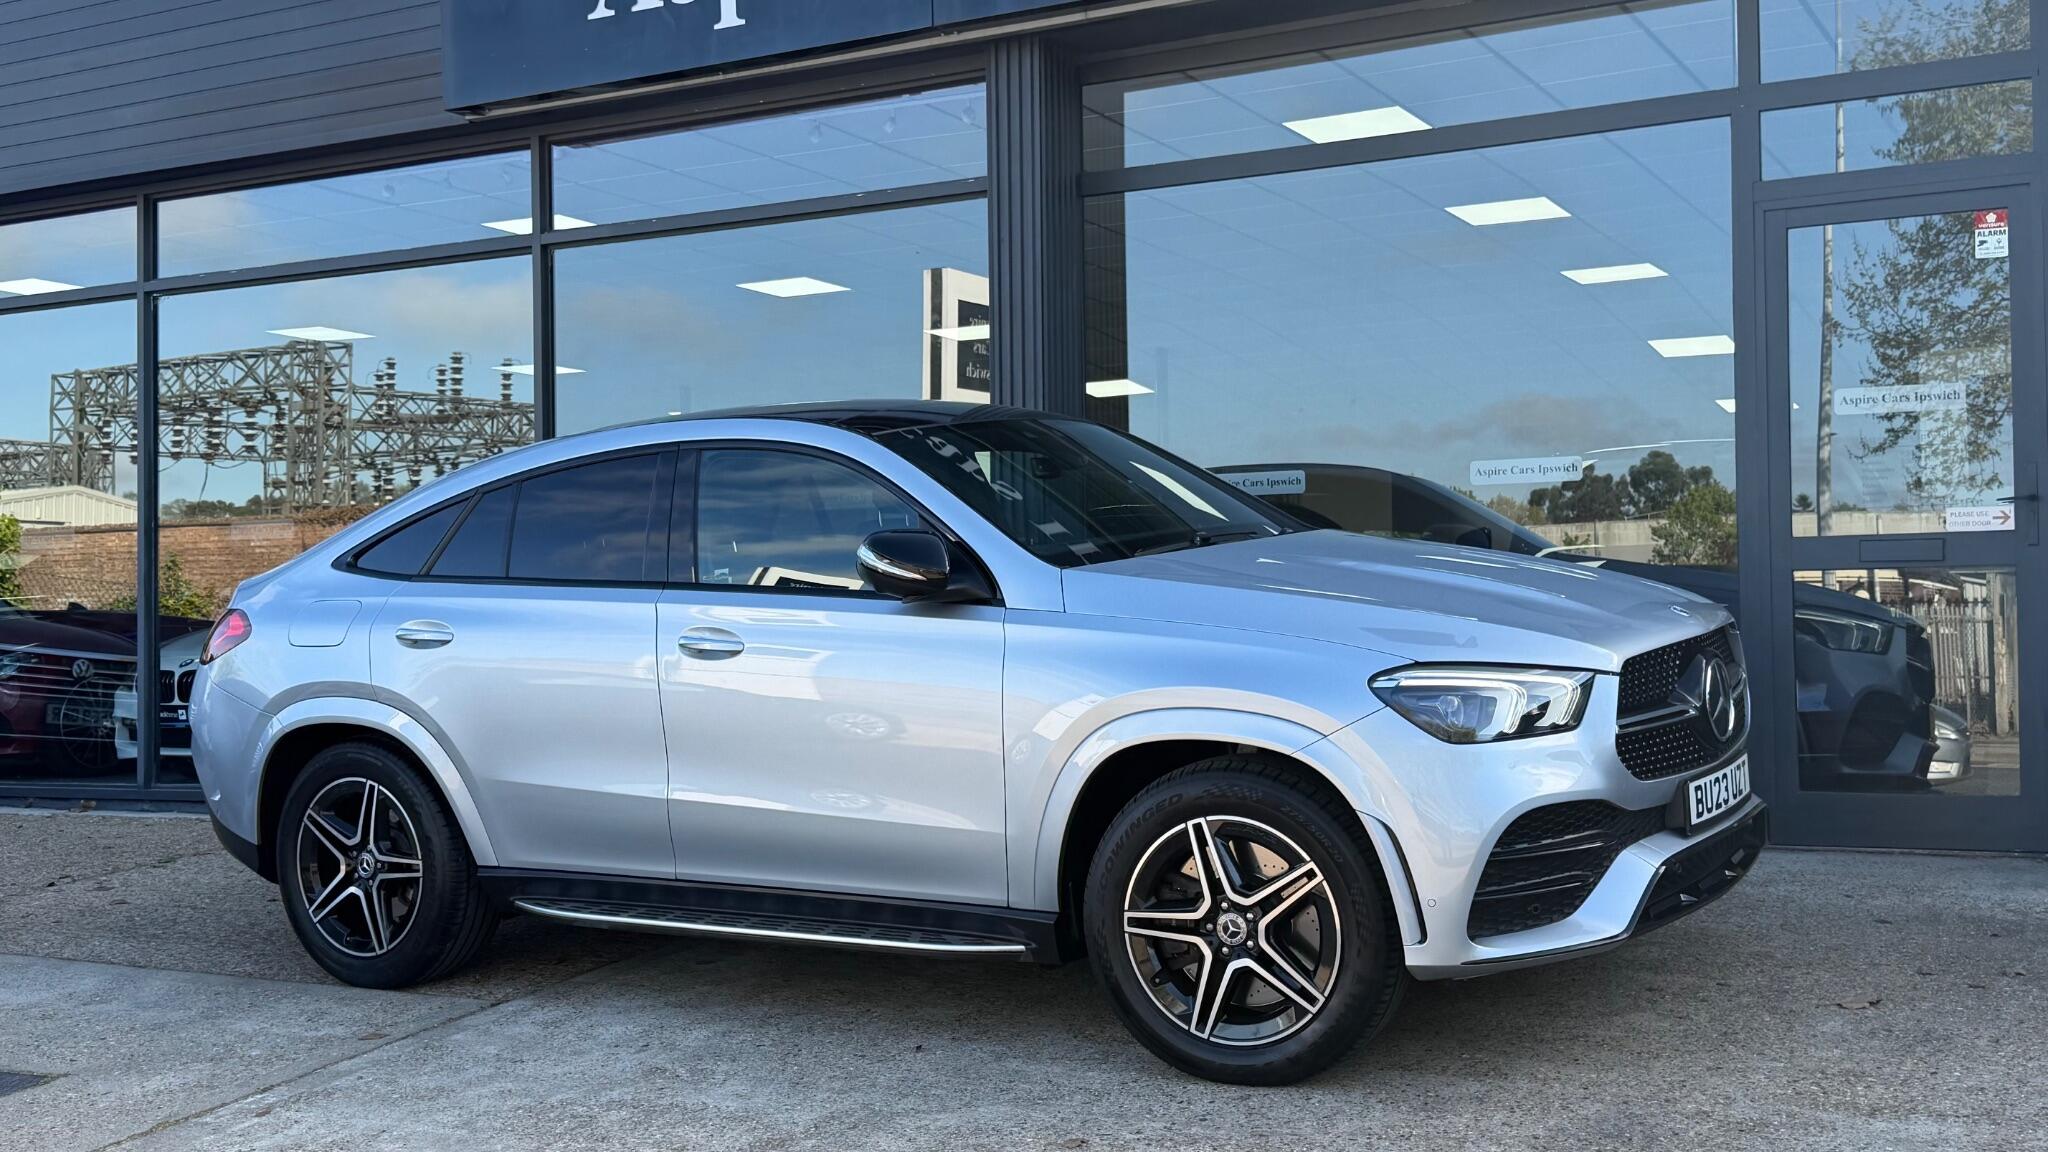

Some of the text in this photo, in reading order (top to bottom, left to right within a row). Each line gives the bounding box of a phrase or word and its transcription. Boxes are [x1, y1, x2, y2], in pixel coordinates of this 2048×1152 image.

[1977, 229, 2007, 237] ALARM
[1840, 390, 1960, 407] Aspire Cars Ipswich
[1475, 463, 1578, 478] Aspire Cars Ipswich
[1242, 478, 1264, 487] Cars
[1266, 477, 1302, 488] Ipswich
[1694, 759, 1747, 819] BU23 UZT
